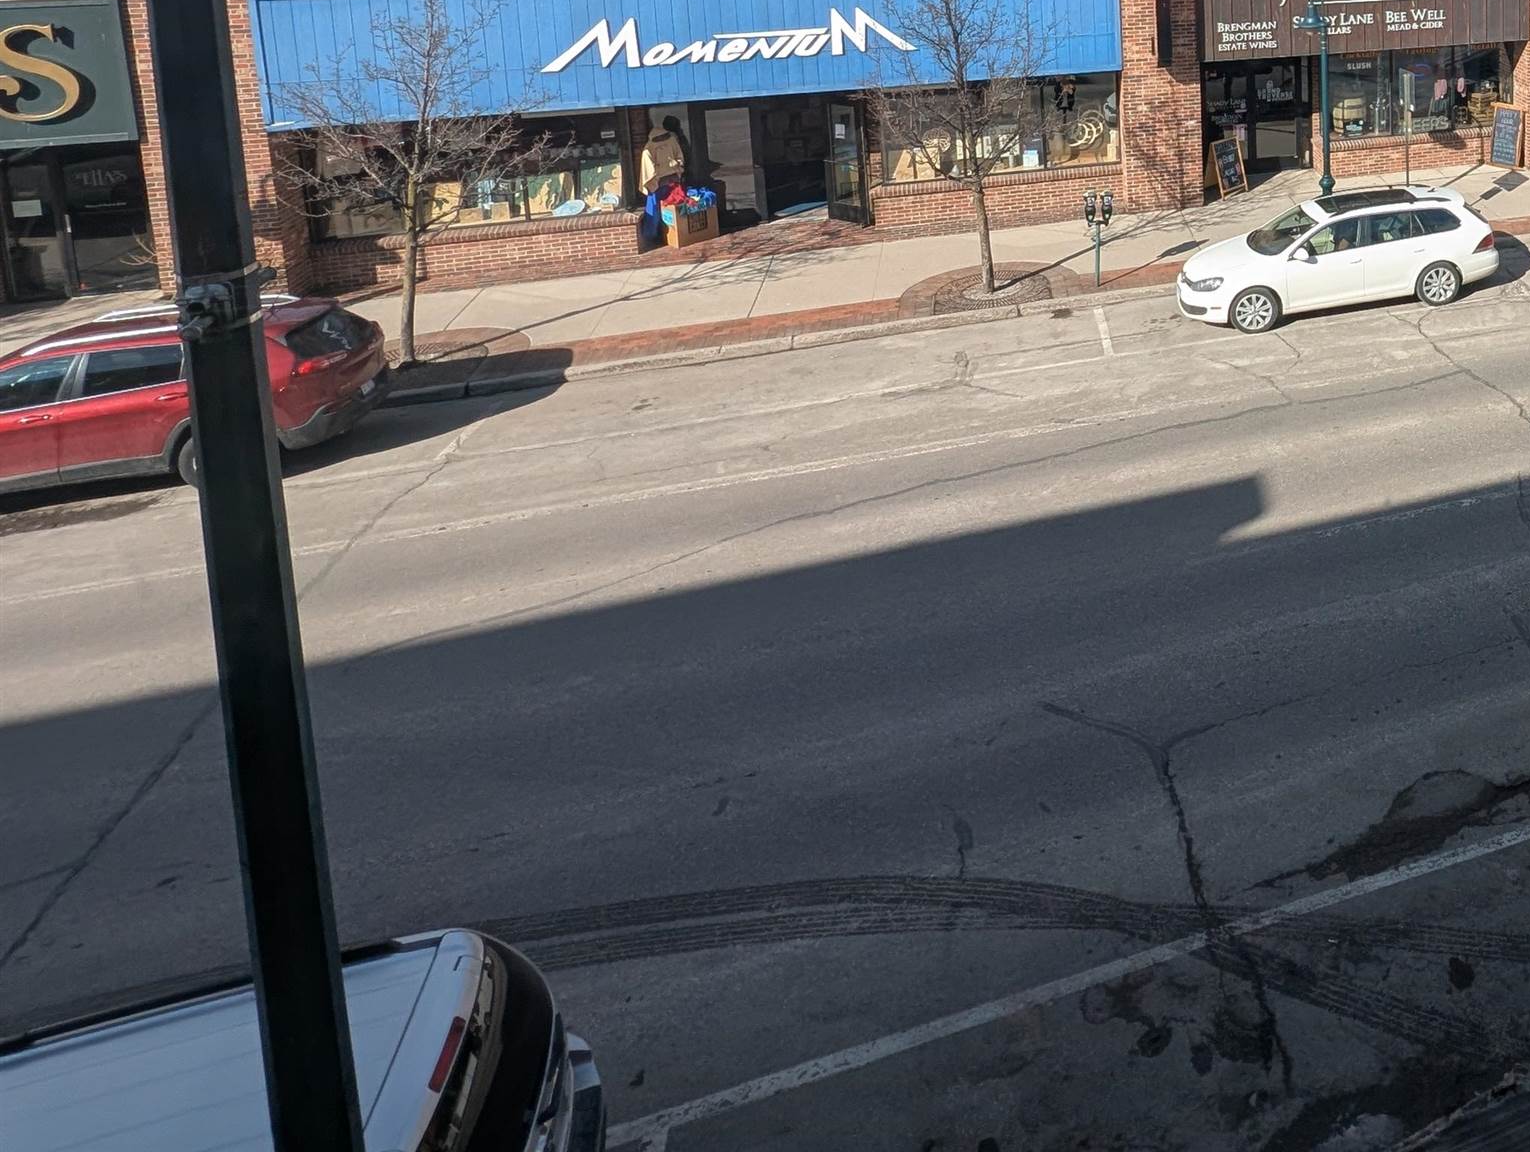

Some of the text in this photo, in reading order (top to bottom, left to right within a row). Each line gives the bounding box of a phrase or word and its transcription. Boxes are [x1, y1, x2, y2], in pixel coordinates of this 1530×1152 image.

[1340, 12, 1374, 26] LANE
[1385, 8, 1446, 24] BEE WELL
[1217, 21, 1276, 32] BRENGMAN
[1387, 21, 1443, 32] MEAD & CIDER
[1222, 31, 1273, 42] BROTHERS
[1218, 41, 1278, 51] ESTATE WINES
[1346, 61, 1372, 70] SLUSH
[0, 24, 80, 122] S
